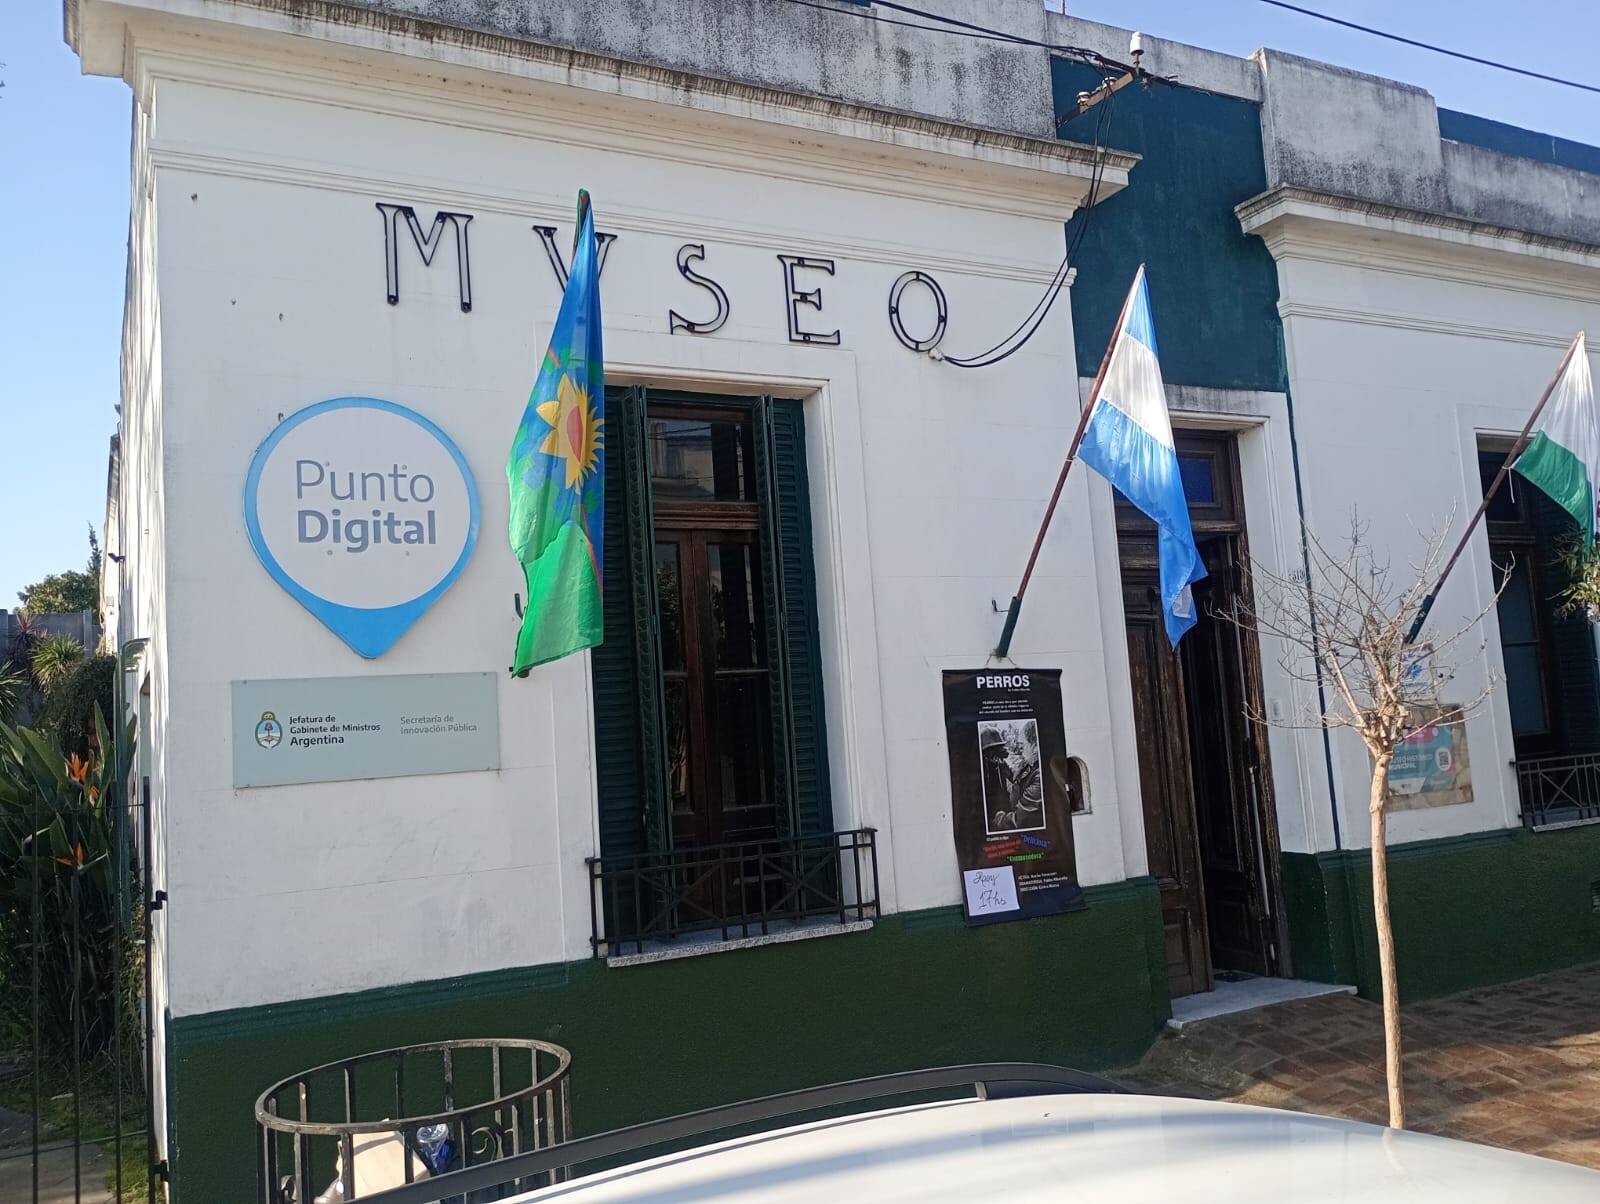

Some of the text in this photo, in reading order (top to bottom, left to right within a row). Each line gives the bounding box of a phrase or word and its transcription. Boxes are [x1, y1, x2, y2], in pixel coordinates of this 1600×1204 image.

[296, 459, 435, 503] Punto
[297, 508, 437, 554] Digital
[976, 674, 1030, 689] PERROS
[289, 714, 336, 725] Jefatura de
[443, 713, 454, 722] de
[290, 723, 381, 734] Gabinete de Ministros
[290, 734, 344, 748] Argentina
